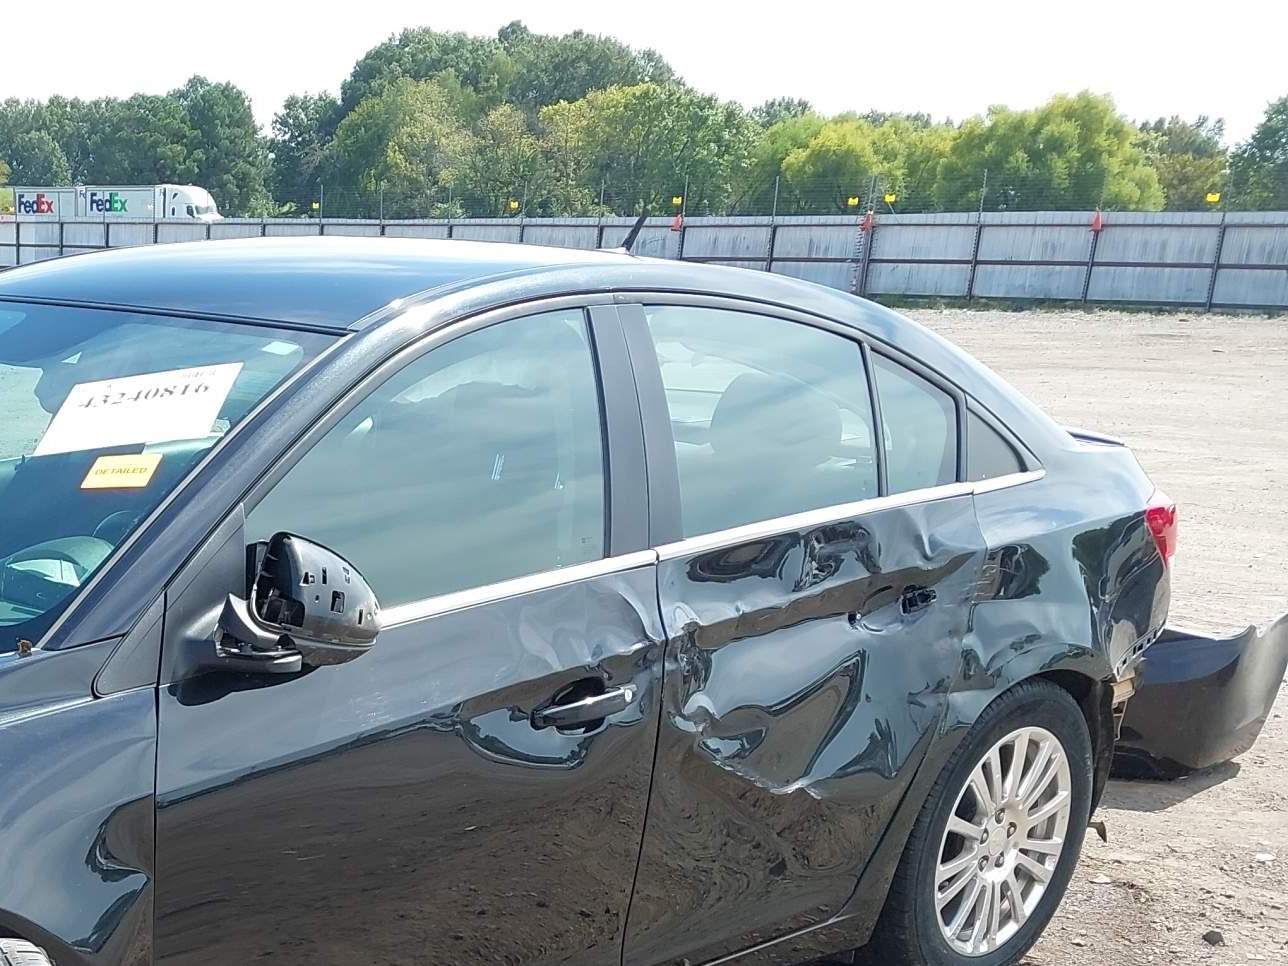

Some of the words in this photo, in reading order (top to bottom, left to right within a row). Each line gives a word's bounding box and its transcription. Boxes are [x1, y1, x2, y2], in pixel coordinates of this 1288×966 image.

[18, 193, 54, 214] FedEx
[90, 191, 129, 213] FedEx
[78, 382, 210, 409] 43240816
[94, 466, 148, 476] DETAILED
